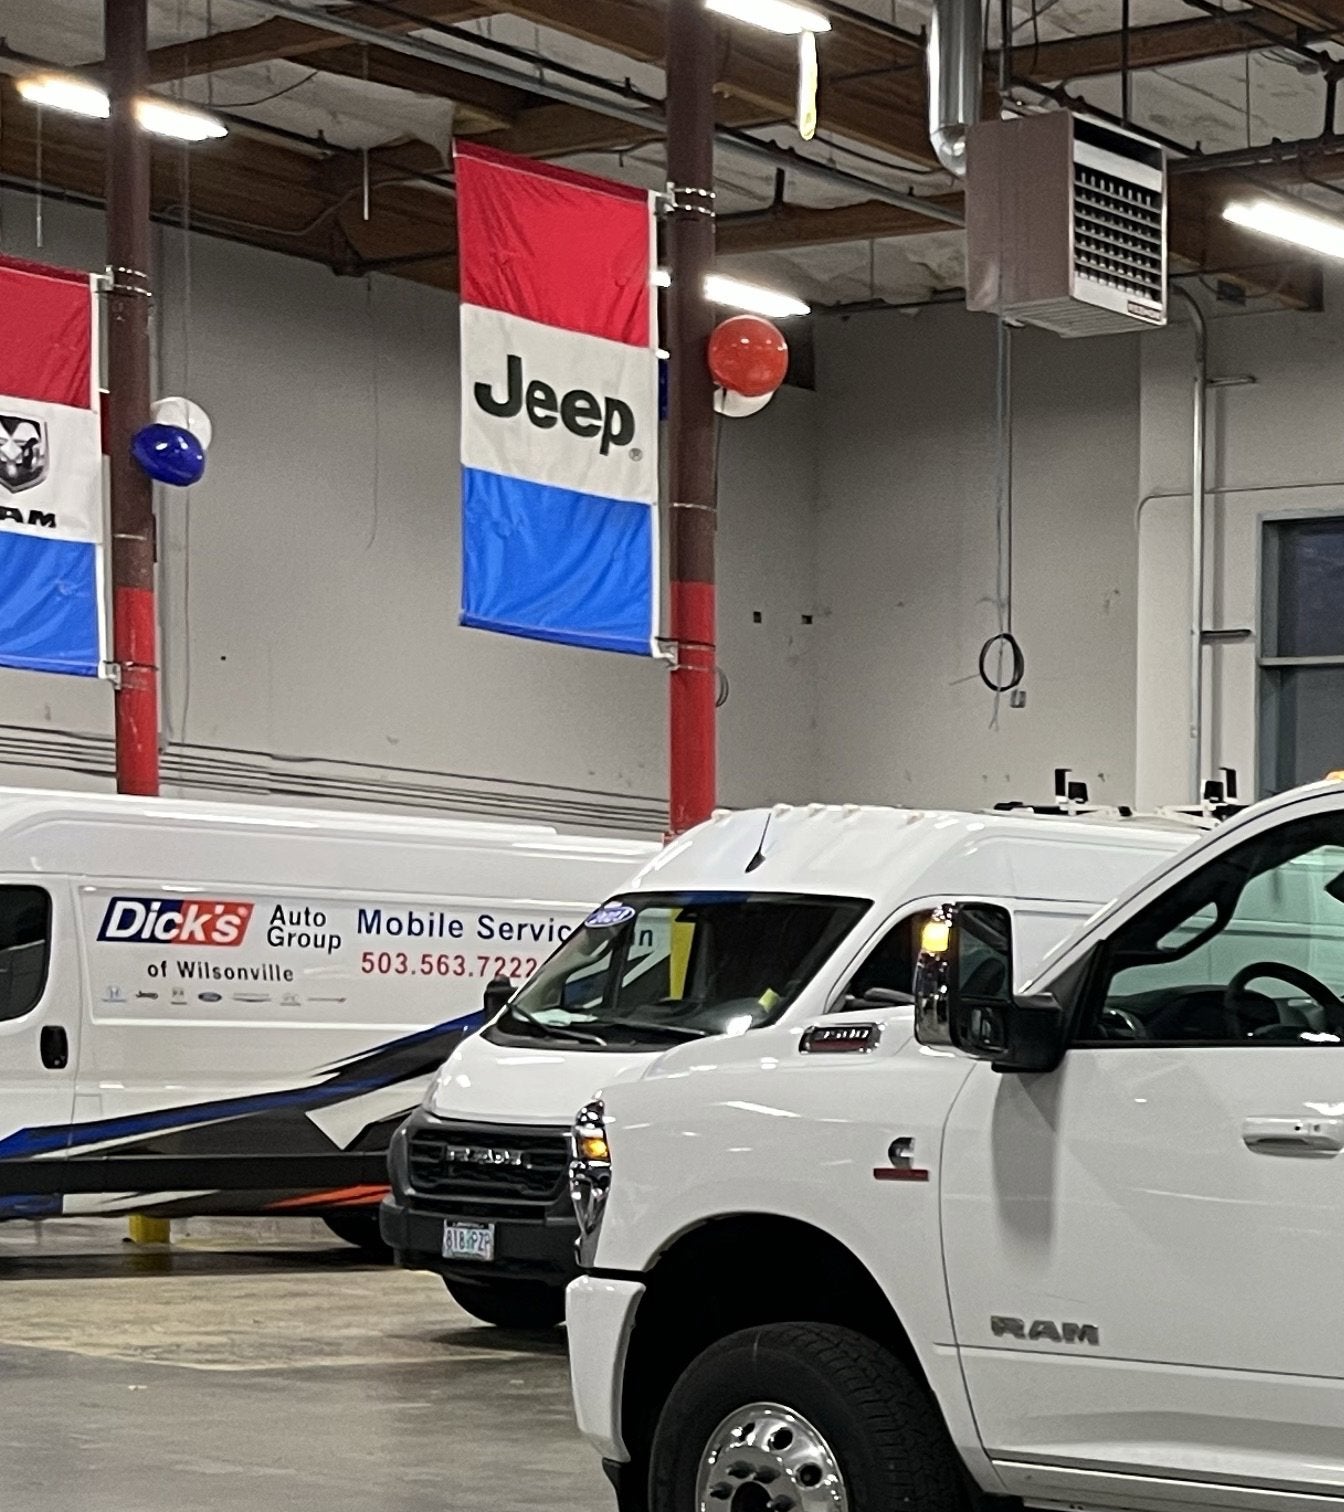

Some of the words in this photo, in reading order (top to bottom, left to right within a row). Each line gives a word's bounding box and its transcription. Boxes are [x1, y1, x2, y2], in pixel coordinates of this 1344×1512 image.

[474, 354, 635, 456] Jeep
[0, 506, 56, 528] AM
[105, 901, 241, 943] Dick's
[270, 904, 326, 927] Auto
[357, 908, 464, 938] Mobile
[477, 914, 573, 942] Servic
[267, 926, 341, 954] Group
[147, 961, 167, 978] of
[177, 961, 294, 982] Wilsonville
[990, 1315, 1099, 1346] RAM
